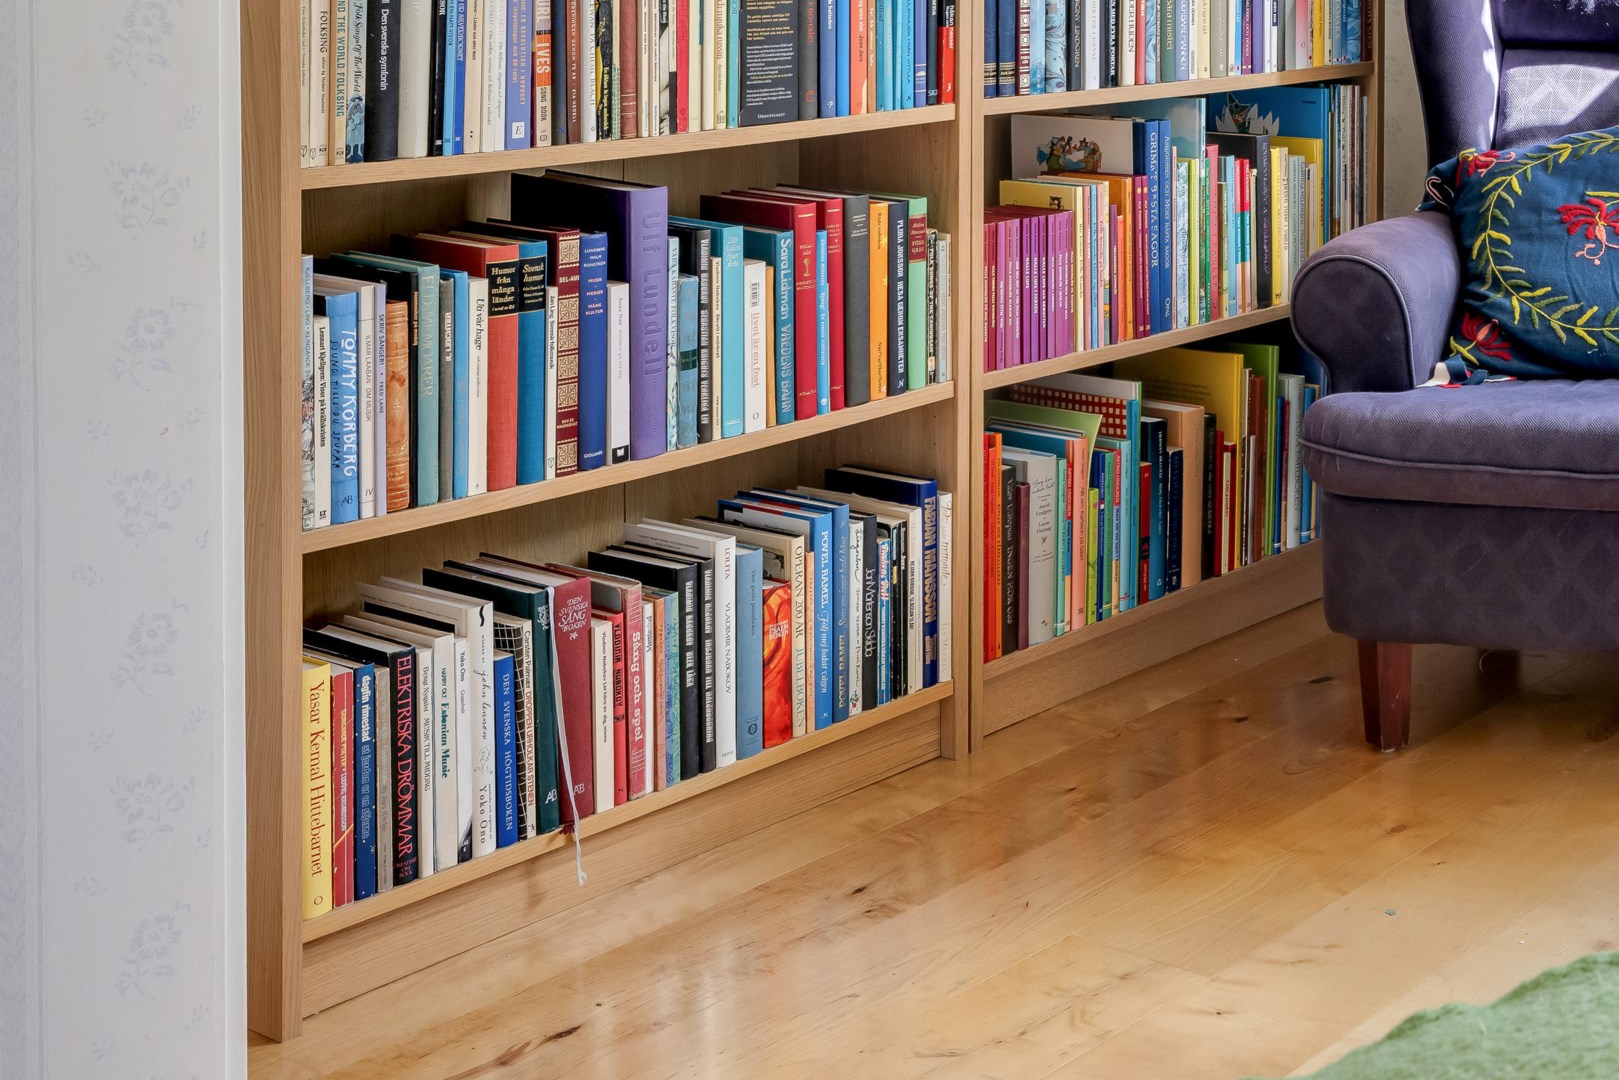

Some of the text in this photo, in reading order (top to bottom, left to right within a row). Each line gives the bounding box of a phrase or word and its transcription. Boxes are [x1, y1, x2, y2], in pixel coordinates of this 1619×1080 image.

[337, 17, 346, 34] THE
[380, 26, 388, 55] svenska
[336, 37, 346, 69] WORLD
[379, 56, 388, 90] symfonin
[336, 72, 345, 117] FOLKSING
[491, 287, 515, 295] många
[496, 276, 511, 284] från
[642, 212, 662, 376] Ulf Lundell
[474, 298, 485, 351] Uti vår hage
[318, 352, 326, 381] Kjellgren:
[318, 399, 325, 407] på
[341, 328, 358, 477] TOMMY KÖRBERG
[795, 545, 804, 598] OPERAN
[821, 530, 829, 609] POVEL RAMEL
[795, 601, 803, 619] 200
[630, 631, 643, 742] Sång och spel
[525, 691, 533, 730] DROPPEN
[397, 655, 414, 858] ELEKTRISKA DRÖMMAR
[440, 702, 450, 779] Estonian Music
[526, 730, 534, 773] URHOLKAR
[310, 680, 326, 878] Yasar Kemal Hittebarnet
[504, 751, 513, 830] HÖGTIDSBOKEN
[527, 774, 535, 806] STENEN
